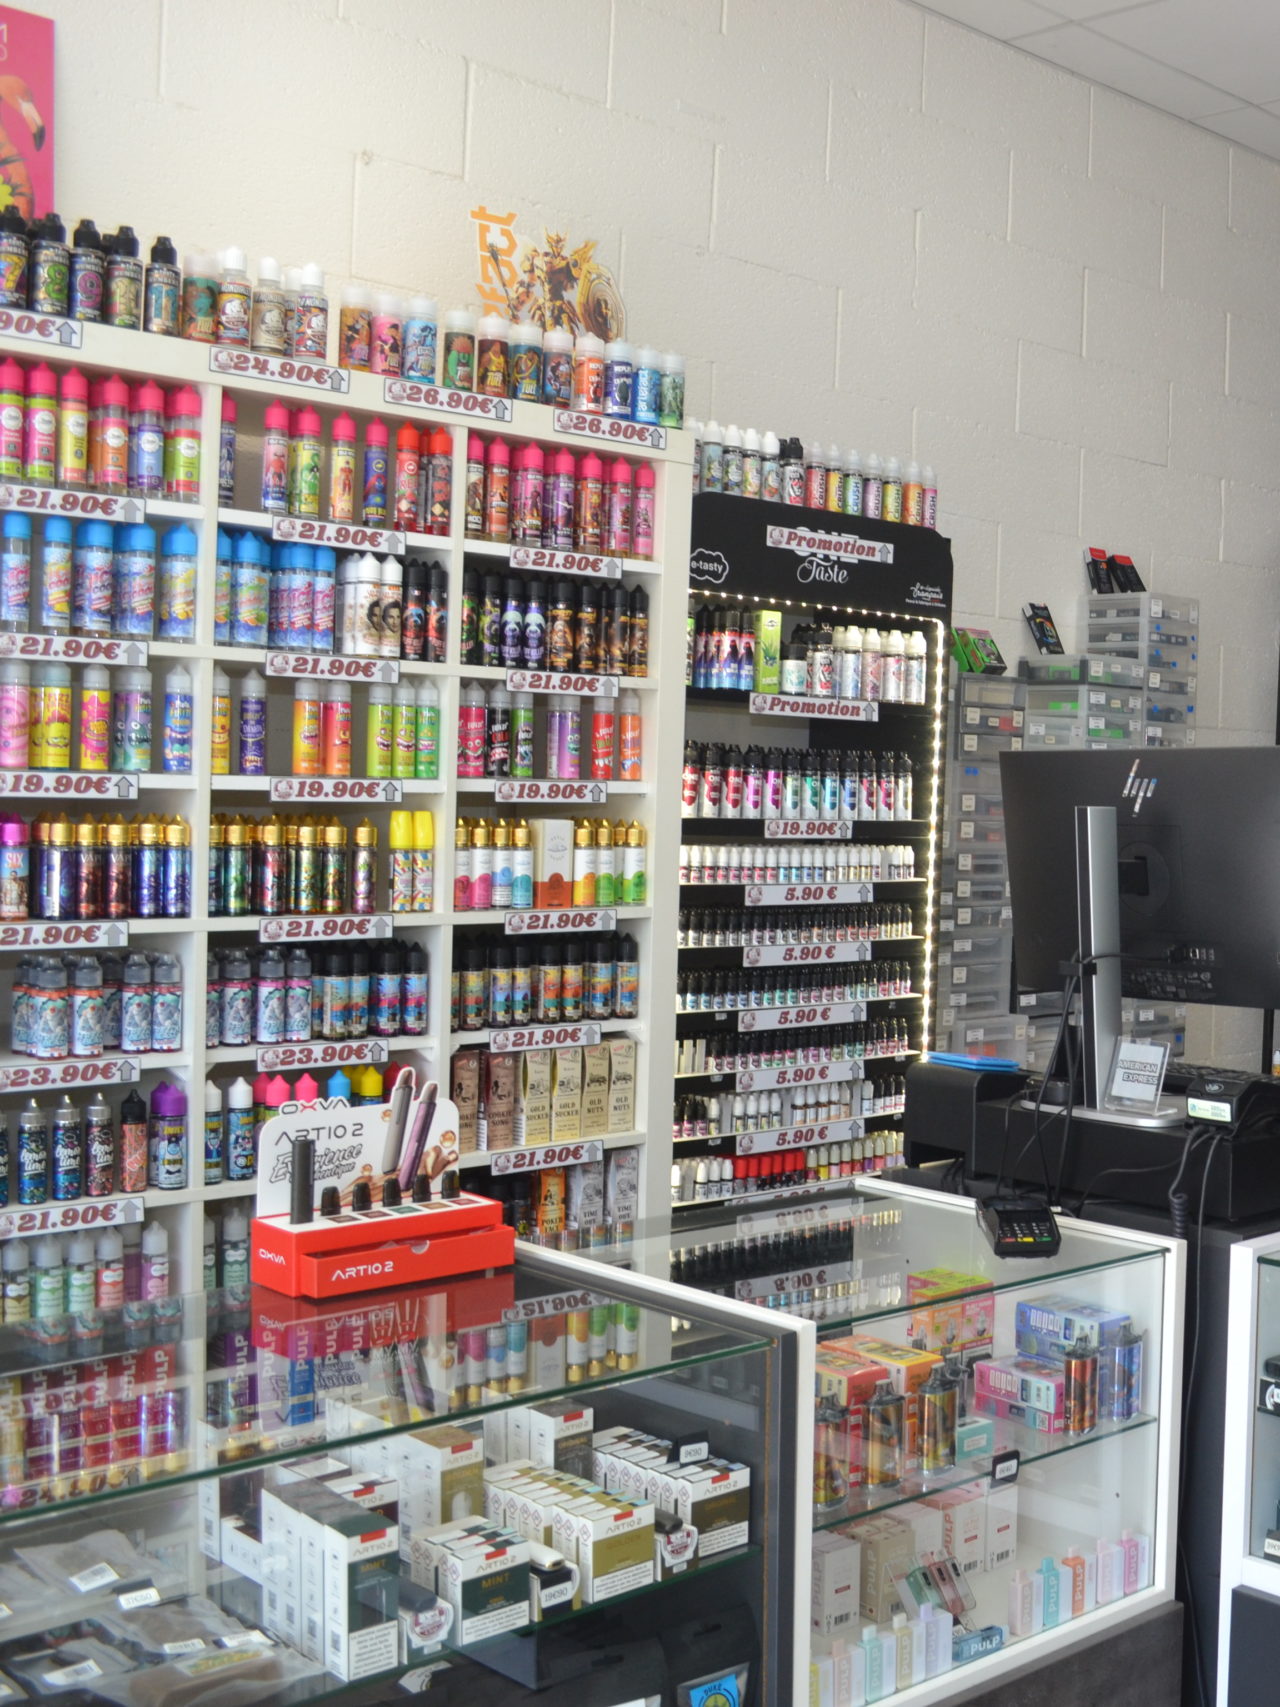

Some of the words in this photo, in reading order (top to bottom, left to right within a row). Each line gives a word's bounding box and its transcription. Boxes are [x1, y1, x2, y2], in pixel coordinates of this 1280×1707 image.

[229, 354, 330, 385] 24.90€
[406, 381, 496, 414] 26.90€
[569, 416, 650, 441] 26.90€
[16, 489, 119, 515] 21.90€
[298, 523, 383, 547] 21.90€
[785, 532, 876, 557] Promotion
[531, 552, 603, 572] 21.90€
[691, 560, 723, 573] e-tasty
[797, 556, 848, 584] Taste
[19, 637, 121, 659] 21.90€
[292, 655, 380, 678] 21.90€
[528, 674, 600, 692] 21.90€
[768, 697, 861, 716] Promotion
[9, 775, 112, 793] 19.90€
[295, 781, 380, 798] 19.90€
[516, 784, 588, 799] 19.90€
[781, 822, 838, 835] 19.90€
[785, 888, 823, 900] 5.90
[827, 887, 837, 899] €
[285, 919, 371, 937] 21.90€
[526, 912, 598, 930] 21.90€
[0, 926, 102, 945] 21.90€
[783, 947, 822, 960] 5.90
[825, 946, 836, 958] €
[778, 1009, 817, 1024] 5.90
[820, 1008, 831, 1020] €
[512, 1028, 582, 1047] 21.90€
[278, 1044, 369, 1066] 23.90€
[8, 1063, 118, 1087] 23.90€
[776, 1068, 815, 1083] 5.90
[818, 1067, 829, 1079] €
[1117, 1059, 1158, 1073] AMERICAN
[1122, 1072, 1158, 1085] EXPRESS
[282, 1099, 348, 1115] OXVA
[587, 1105, 604, 1113] NUTS
[613, 1103, 630, 1112] NUTS
[616, 1096, 628, 1104] OLD
[275, 1124, 347, 1146] ARTIO
[352, 1123, 364, 1136] 2
[776, 1129, 815, 1145] 5.90
[818, 1127, 828, 1139] €
[512, 1146, 584, 1168] 21.90€
[17, 1204, 118, 1232] 21.90€
[259, 1249, 286, 1265] OXVA
[332, 1263, 382, 1281] ARTIO
[384, 1261, 394, 1273] 2
[704, 1482, 731, 1495] ARTIO
[606, 1519, 635, 1534] ARTIO
[476, 1559, 508, 1574] ARTIO
[481, 1572, 510, 1589] MINT
[1075, 1565, 1084, 1599] PULP
[971, 1635, 999, 1655] PULP
